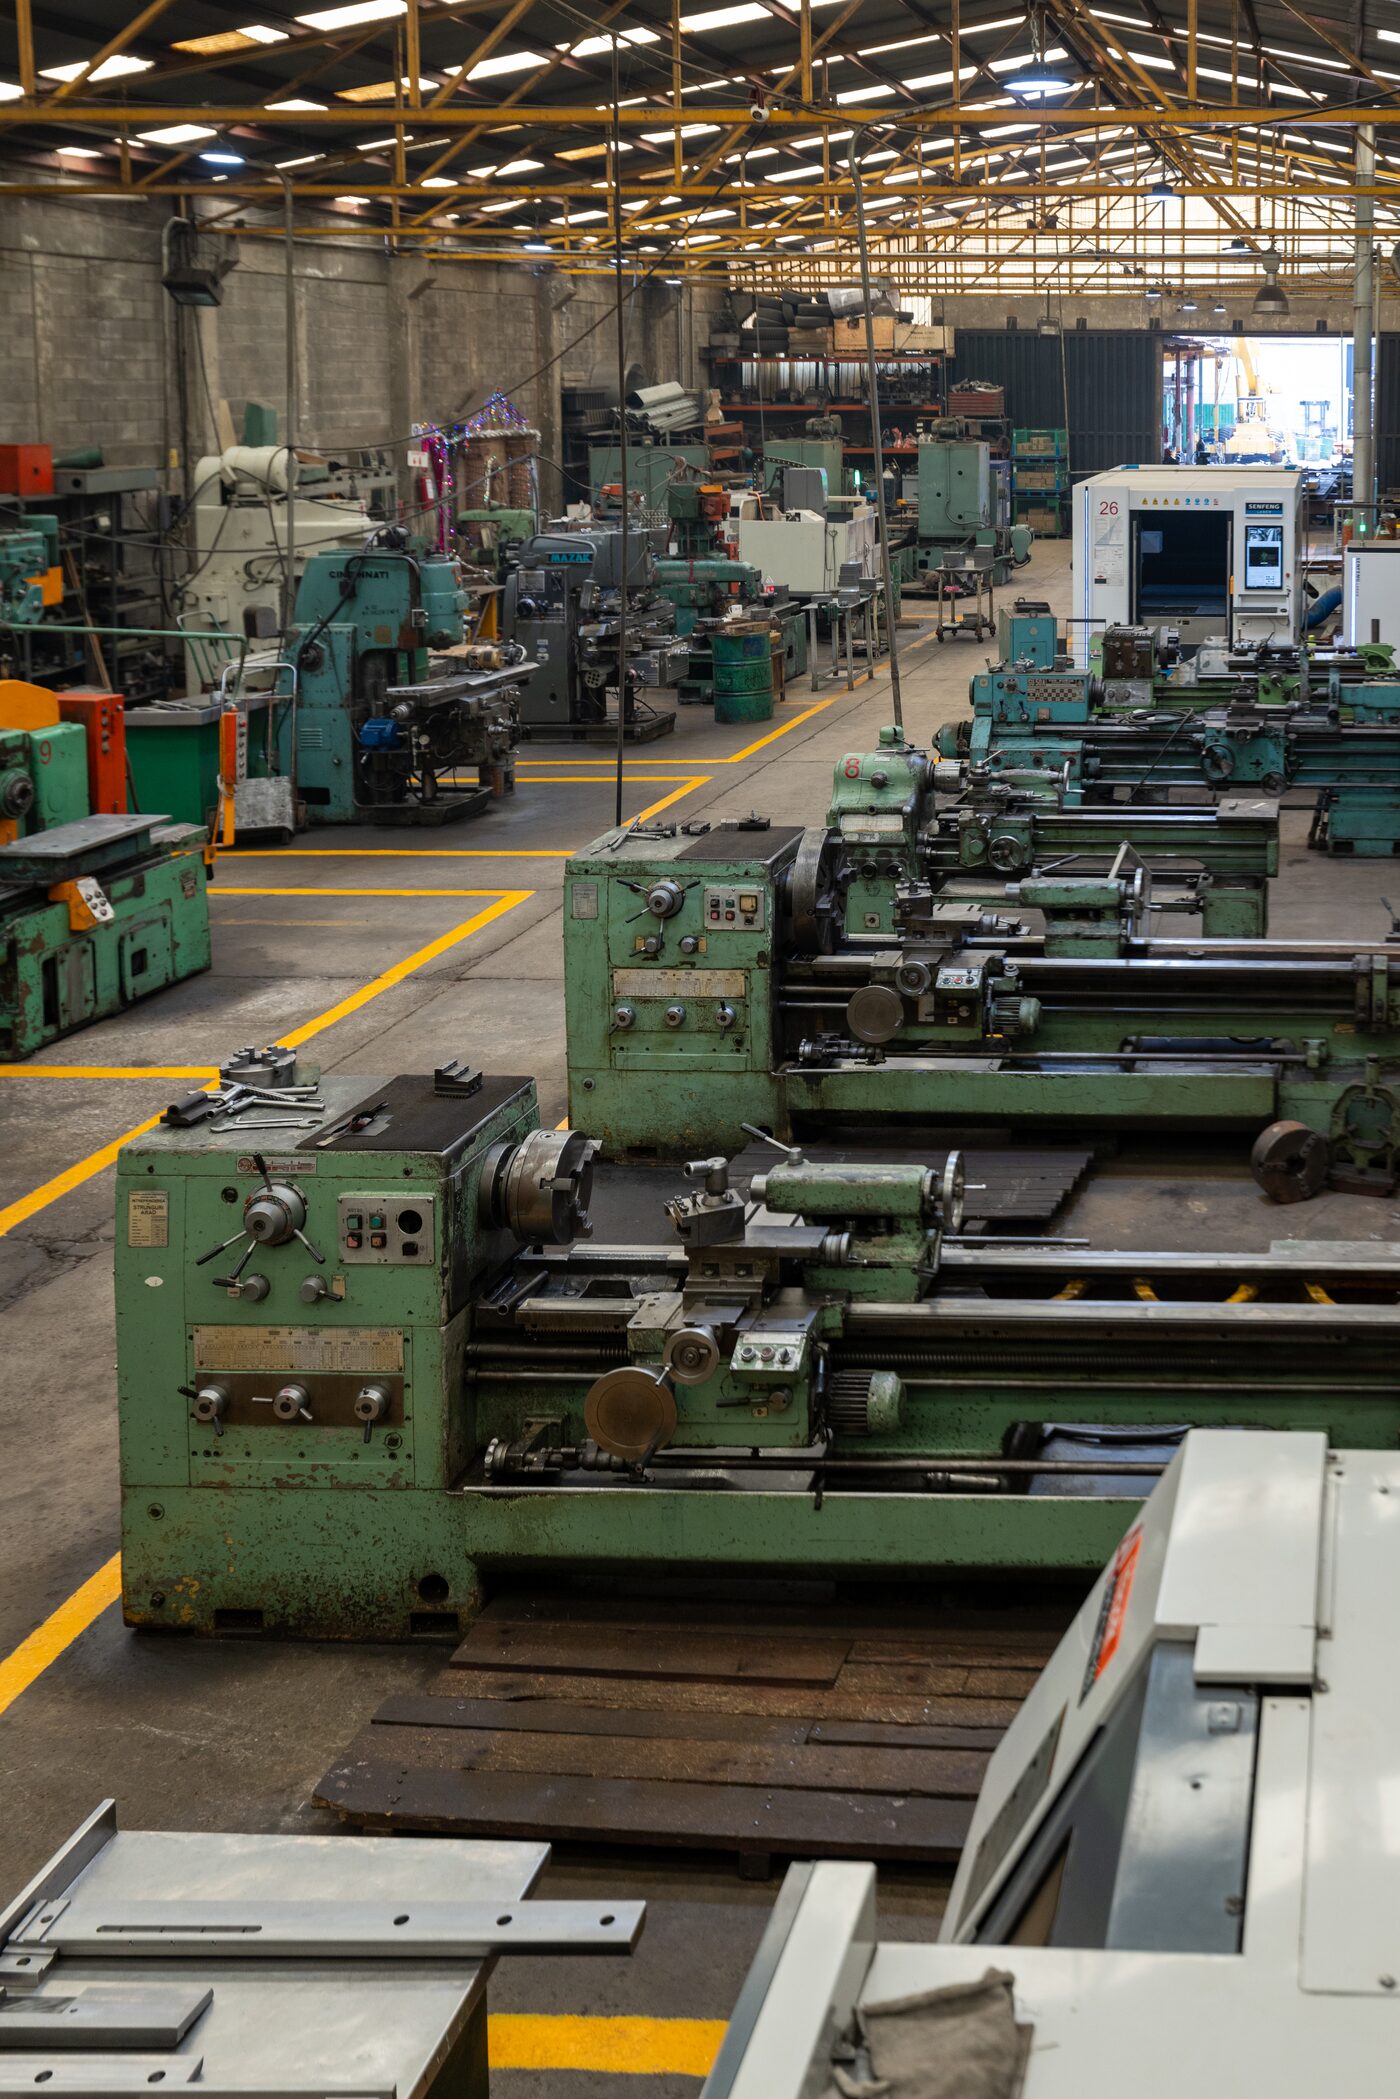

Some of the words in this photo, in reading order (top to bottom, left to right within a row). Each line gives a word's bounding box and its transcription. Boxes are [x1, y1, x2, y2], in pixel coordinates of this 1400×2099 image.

[1099, 501, 1119, 515] 26
[551, 553, 590, 563] MAZAK
[39, 740, 52, 765] 9
